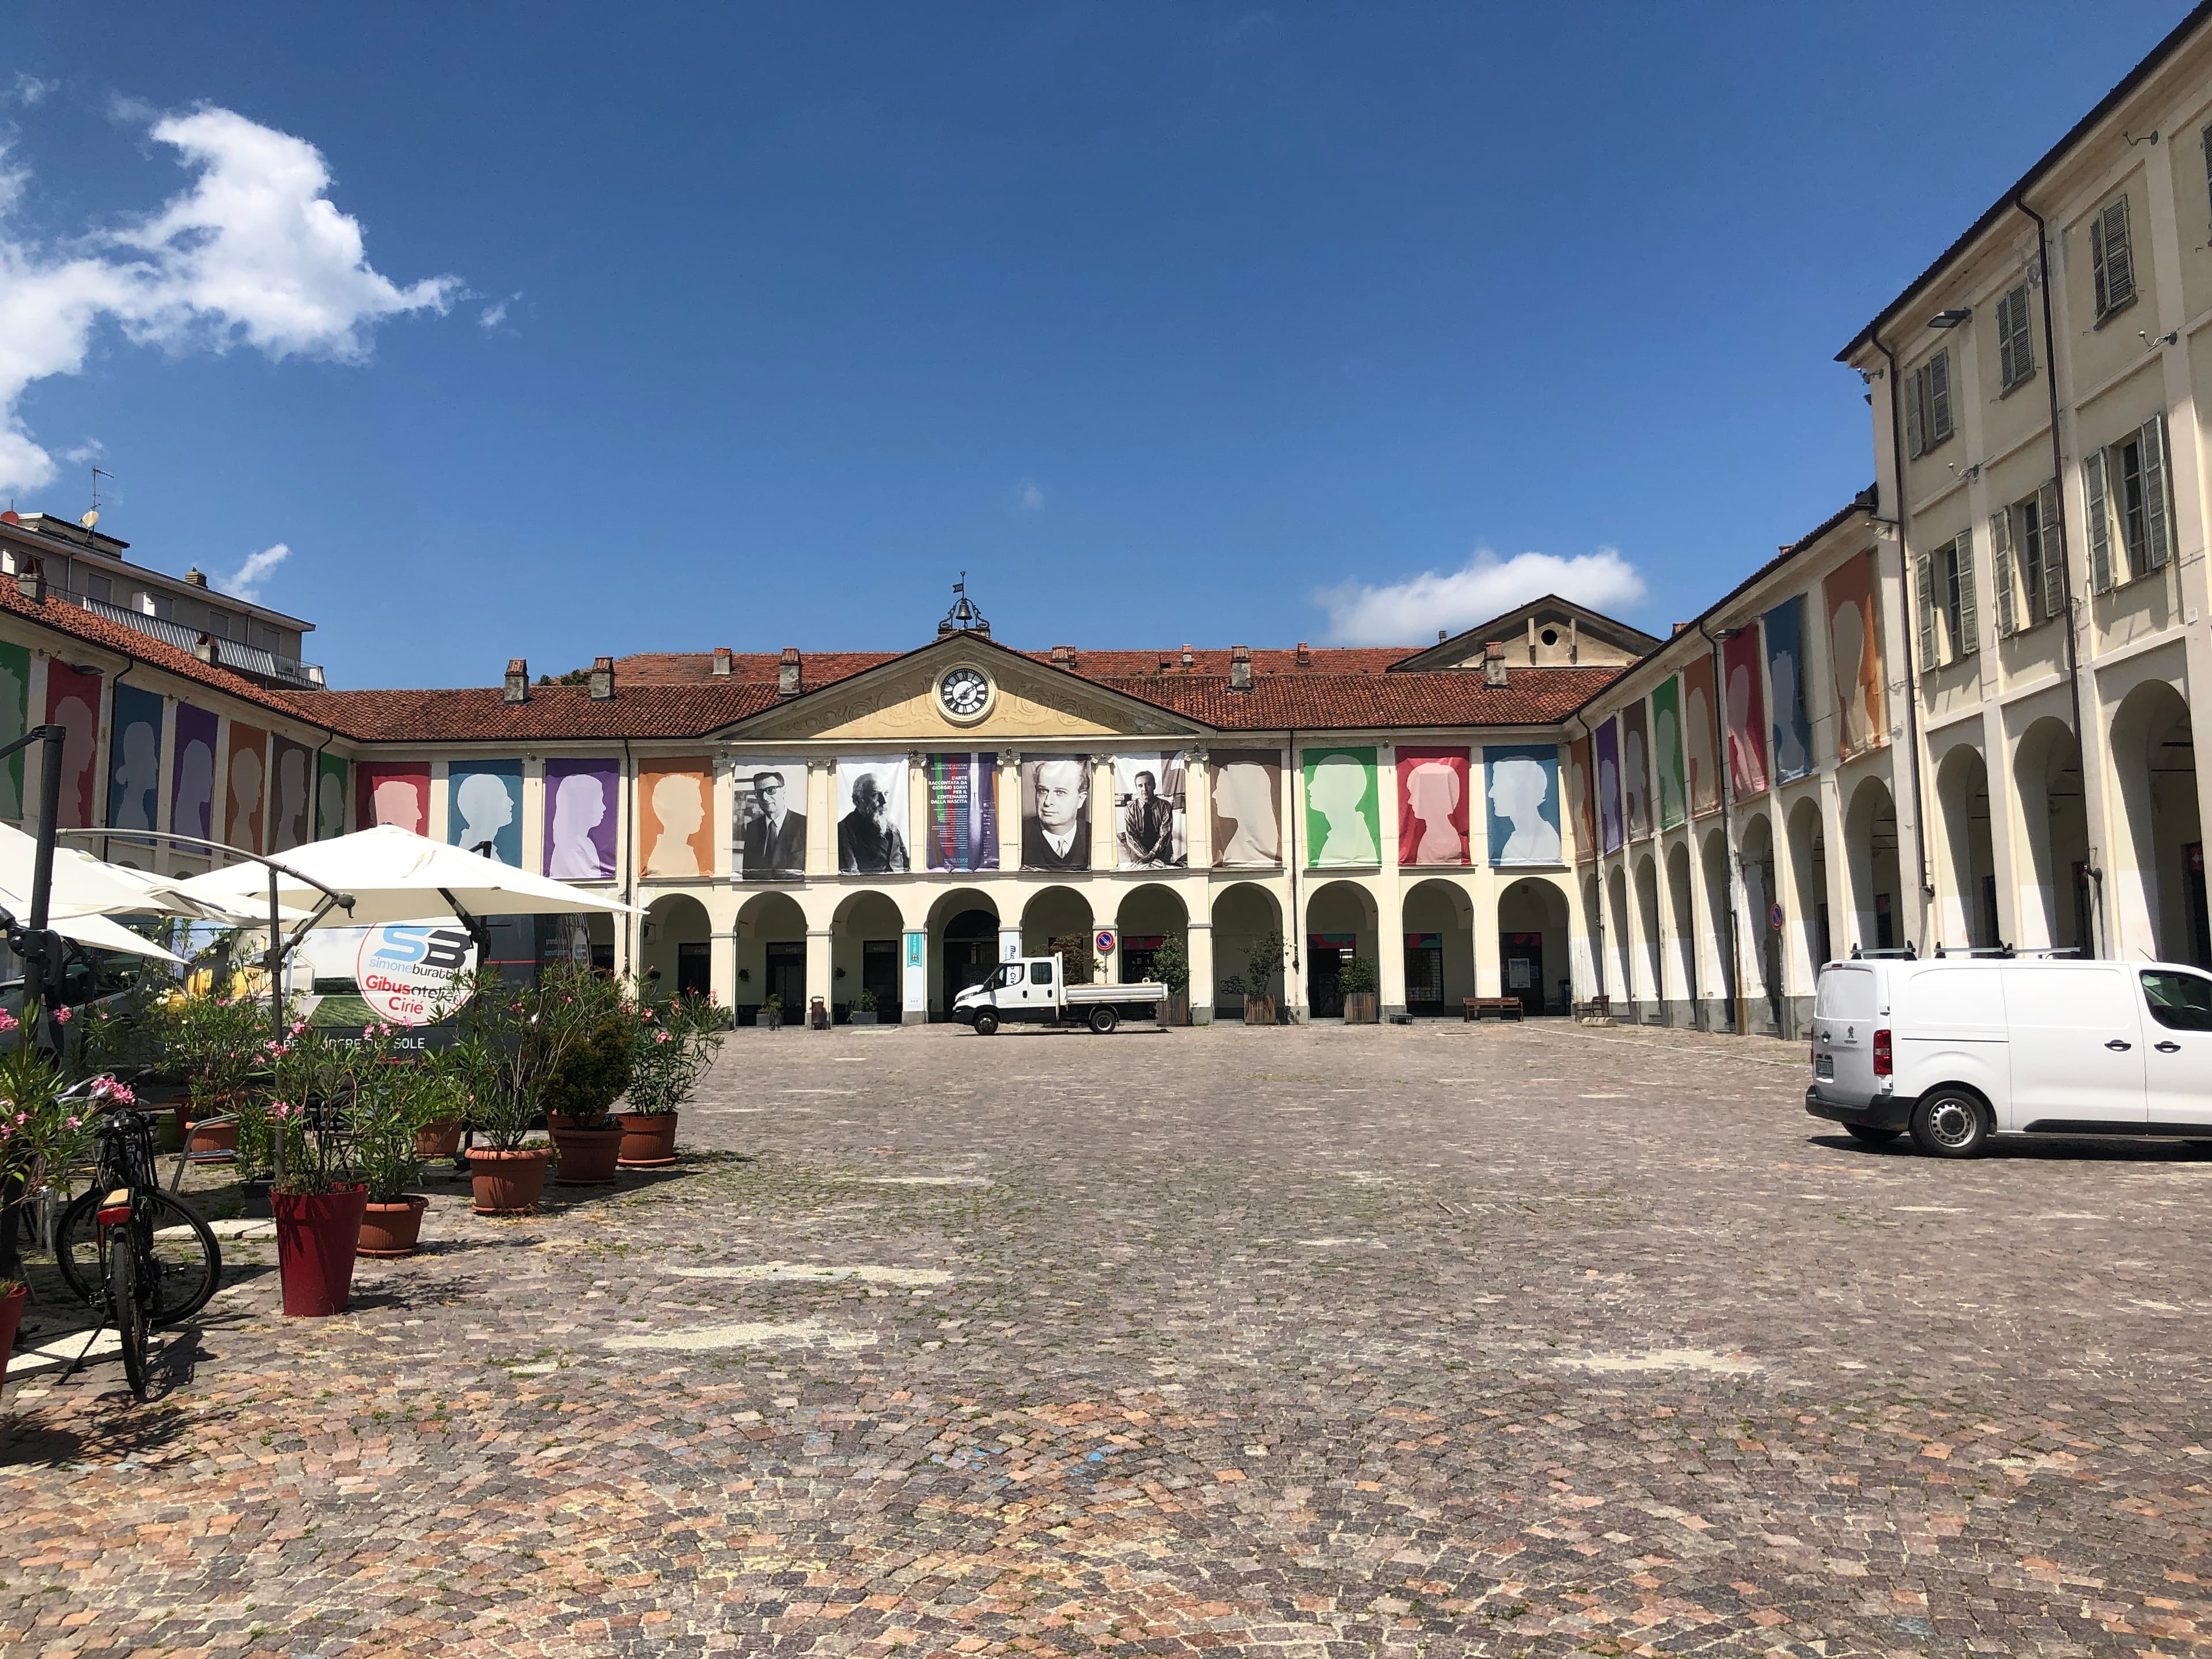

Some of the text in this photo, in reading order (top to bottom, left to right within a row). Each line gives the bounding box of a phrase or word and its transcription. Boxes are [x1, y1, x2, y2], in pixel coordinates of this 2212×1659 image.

[373, 923, 472, 969] SB
[369, 957, 454, 980] simoneburatt
[388, 997, 423, 1014] Cirié
[393, 1037, 425, 1050] SOLE
